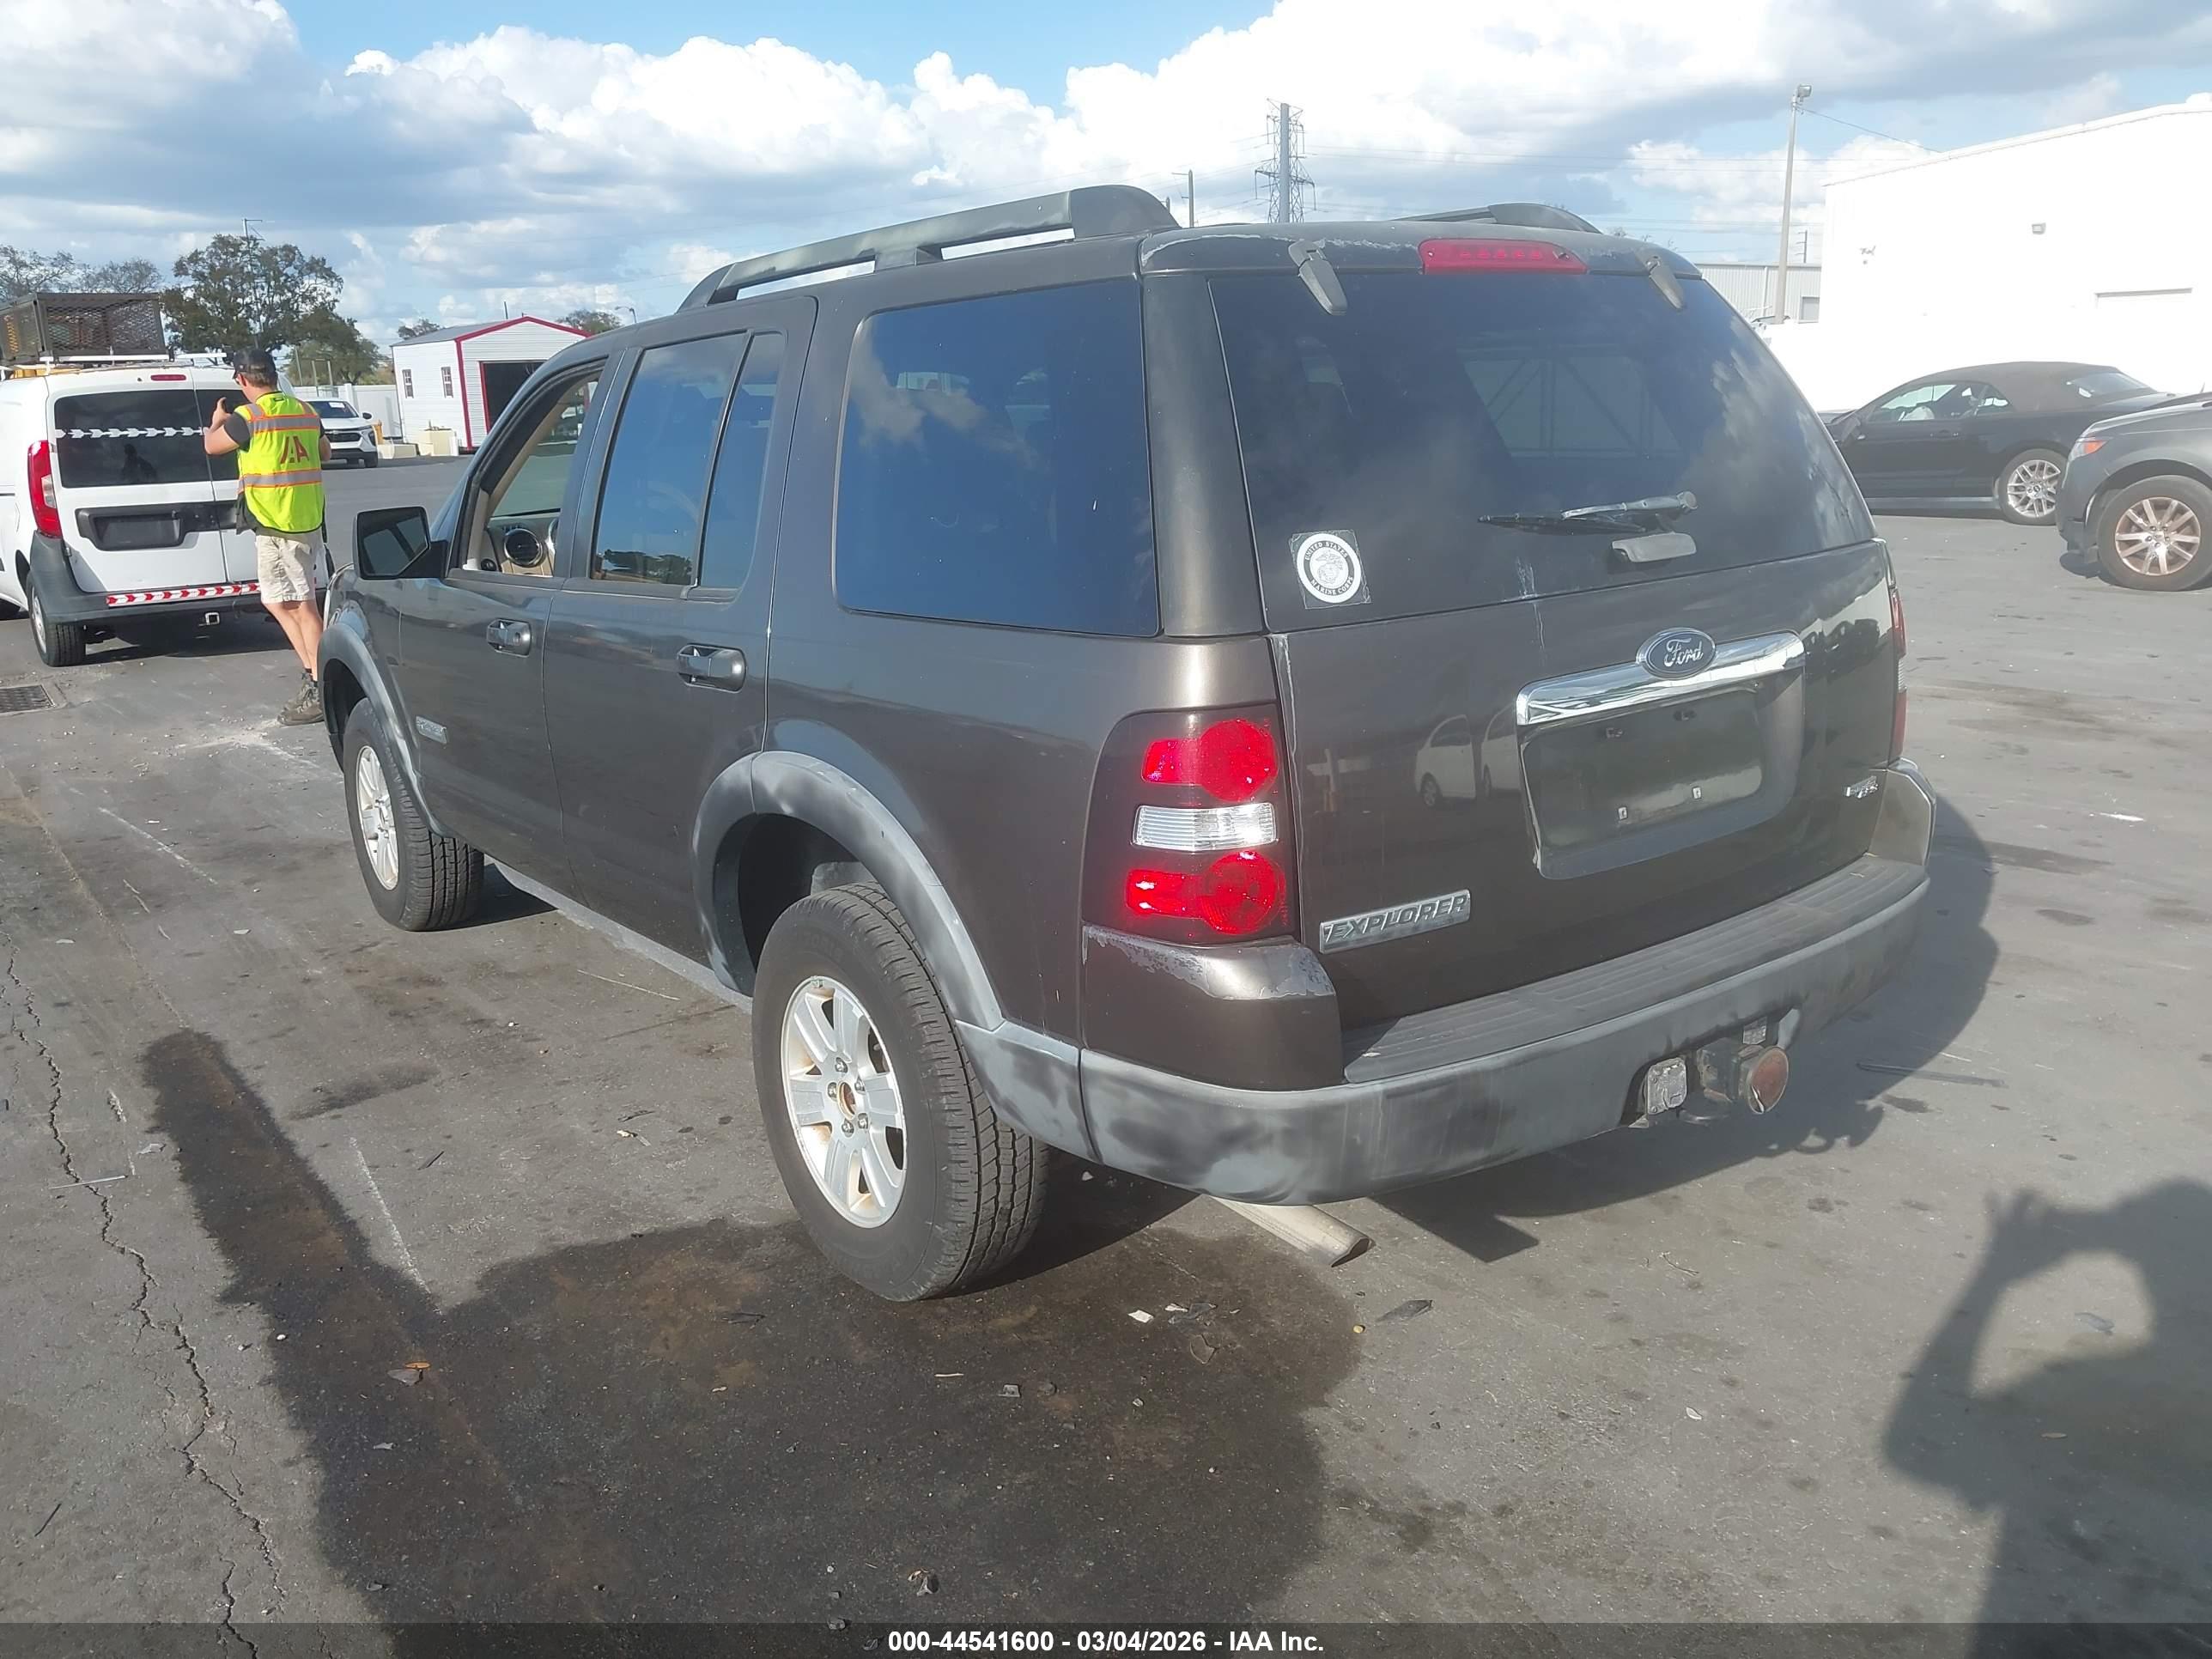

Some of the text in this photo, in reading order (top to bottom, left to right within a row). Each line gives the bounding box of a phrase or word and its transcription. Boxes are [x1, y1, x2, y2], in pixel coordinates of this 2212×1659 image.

[1304, 541, 1349, 562] UNITED STATES
[1310, 575, 1353, 596] MARINE CORPS
[1663, 637, 1705, 667] Ford
[1323, 894, 1468, 944] EXPLORER
